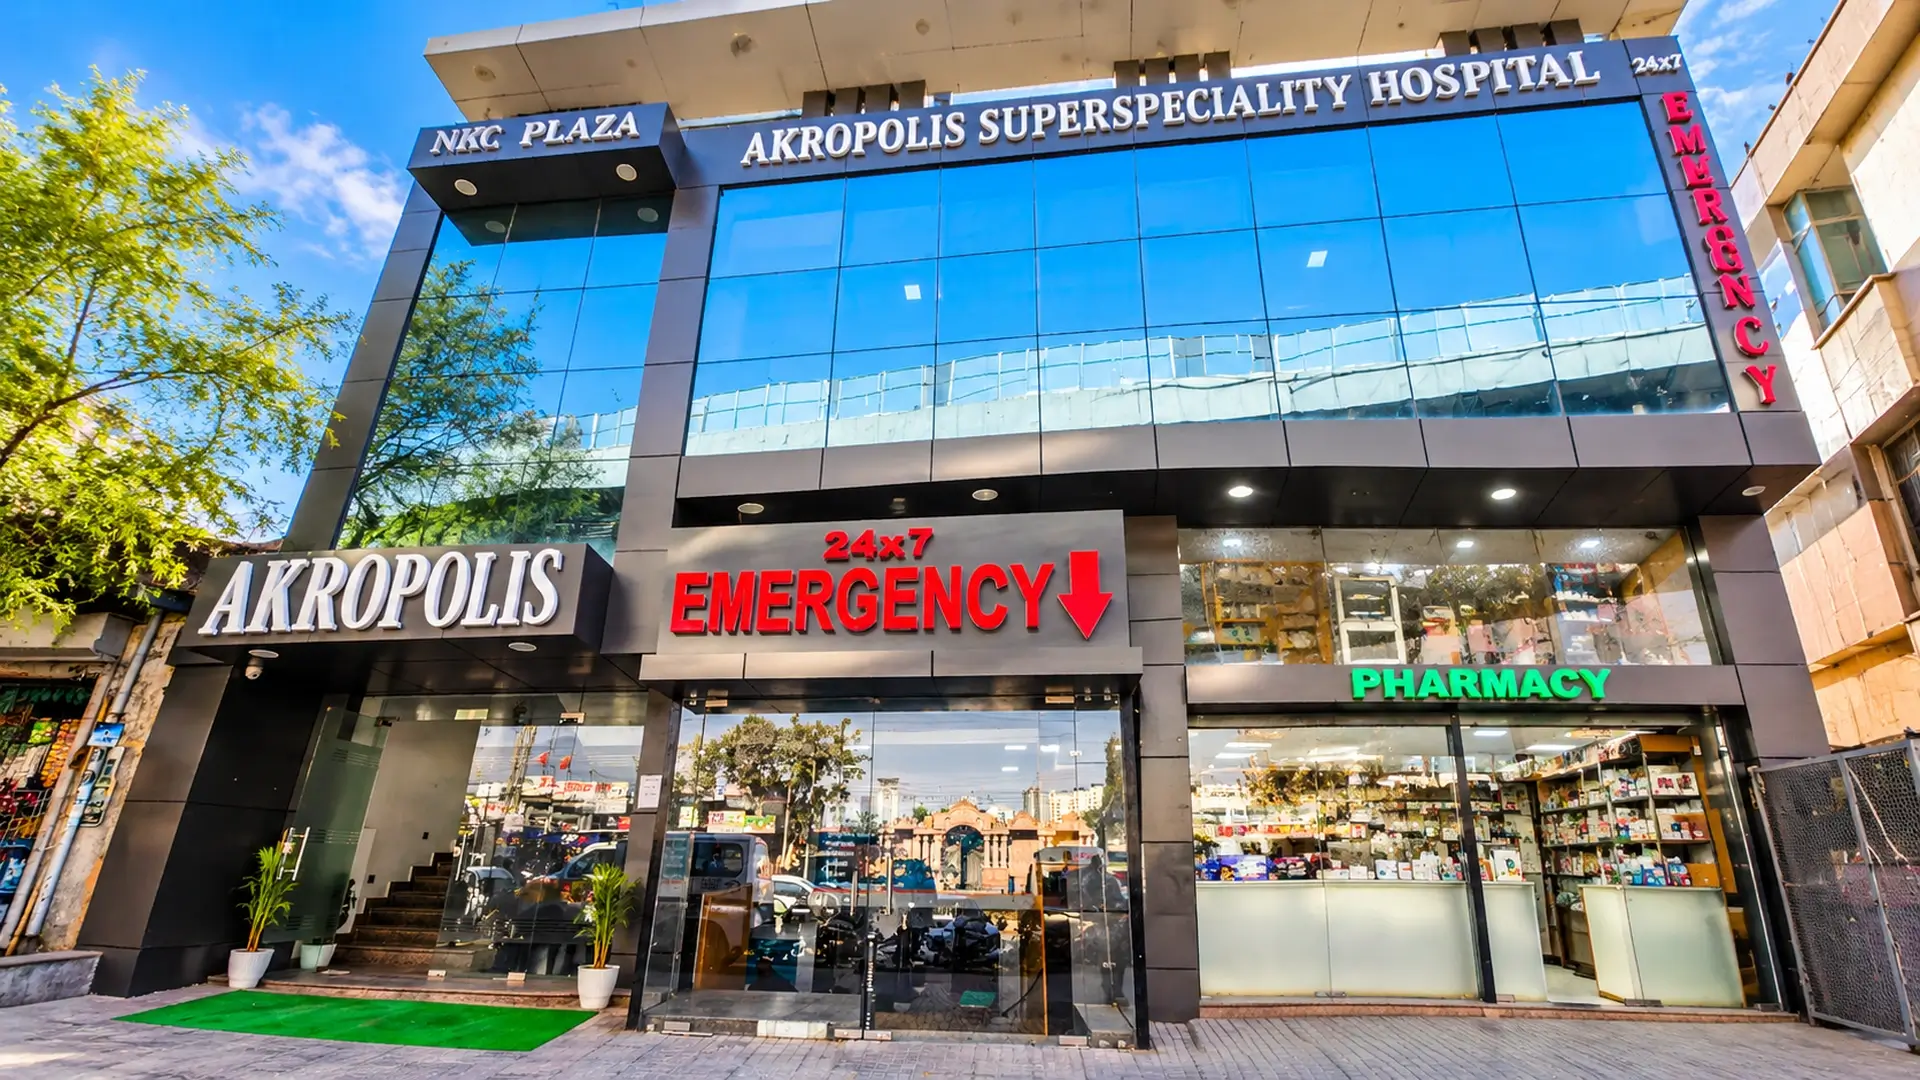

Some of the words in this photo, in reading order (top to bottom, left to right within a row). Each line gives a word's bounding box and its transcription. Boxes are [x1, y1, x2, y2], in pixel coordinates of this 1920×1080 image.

[430, 124, 503, 156] NKC
[519, 110, 640, 148] PLAZA
[740, 111, 966, 167] AKROPOLIS
[979, 74, 1352, 145] SUPERSPECIALITY
[1368, 50, 1600, 105] HOSPITAL
[824, 527, 935, 561] 24x7
[197, 548, 563, 637] AKROPOLIS
[669, 562, 1055, 634] EMERGENCY
[1351, 668, 1611, 700] PHARMACY
